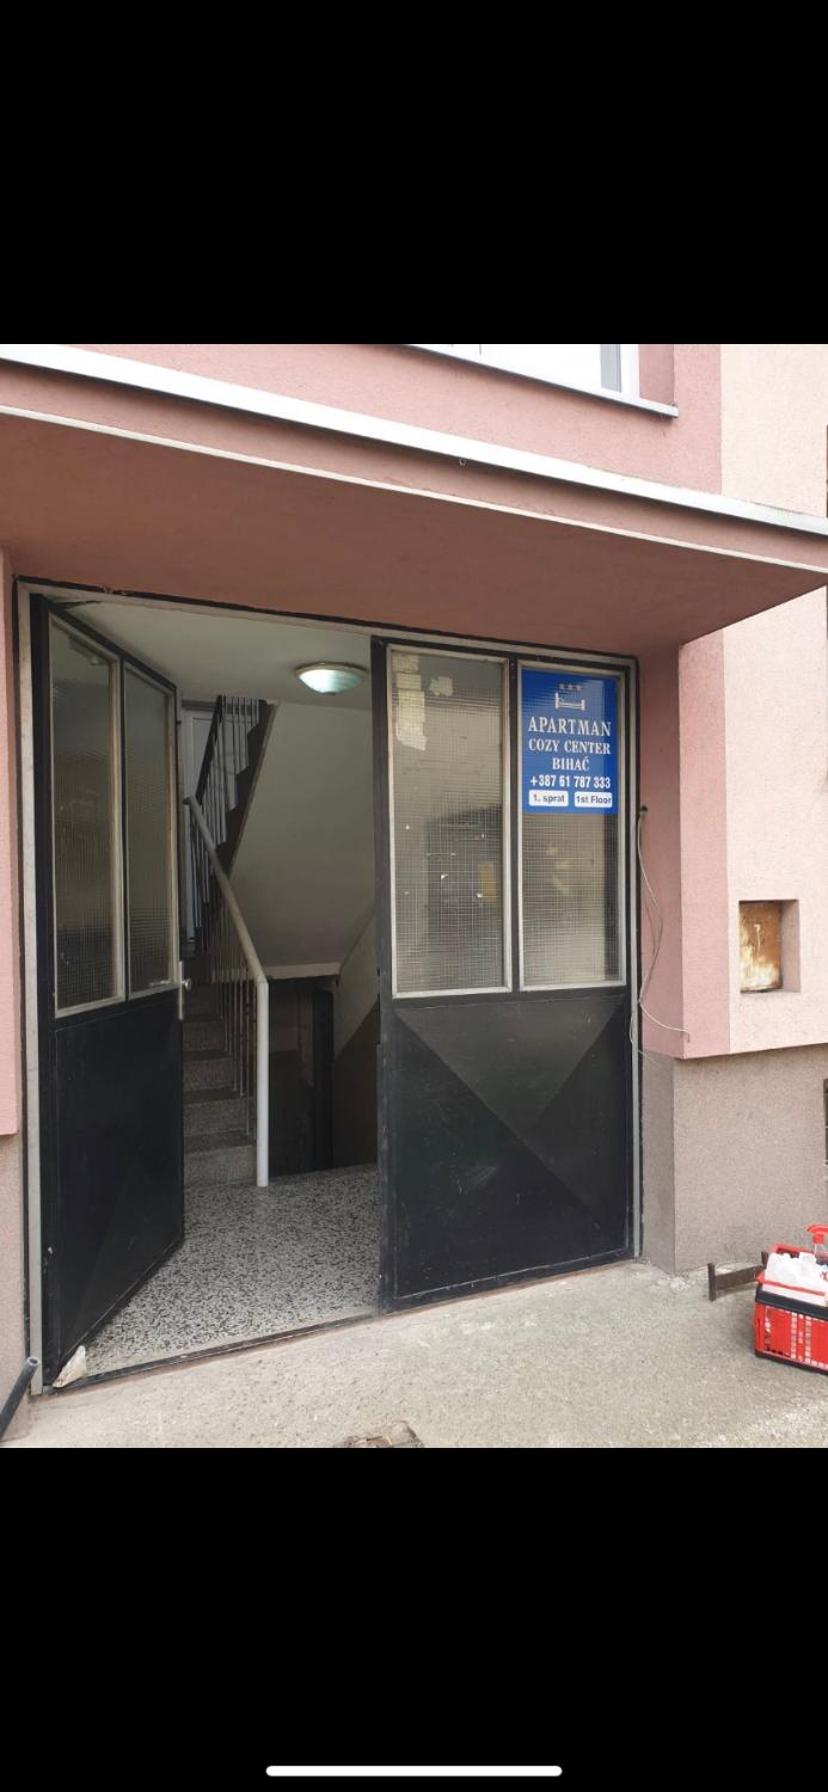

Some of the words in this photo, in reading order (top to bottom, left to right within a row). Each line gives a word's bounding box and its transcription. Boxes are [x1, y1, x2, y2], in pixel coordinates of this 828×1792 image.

[528, 716, 611, 736] APARTMAN
[528, 738, 560, 753] COZY
[563, 740, 611, 755] CENTER
[552, 756, 590, 771] BIHAĆ
[530, 774, 557, 787] +387
[559, 775, 570, 787] 61
[574, 776, 591, 789] 787
[593, 776, 611, 789] 333
[543, 794, 565, 804] sprat
[576, 795, 588, 804] 1st
[590, 796, 612, 805] Floor
